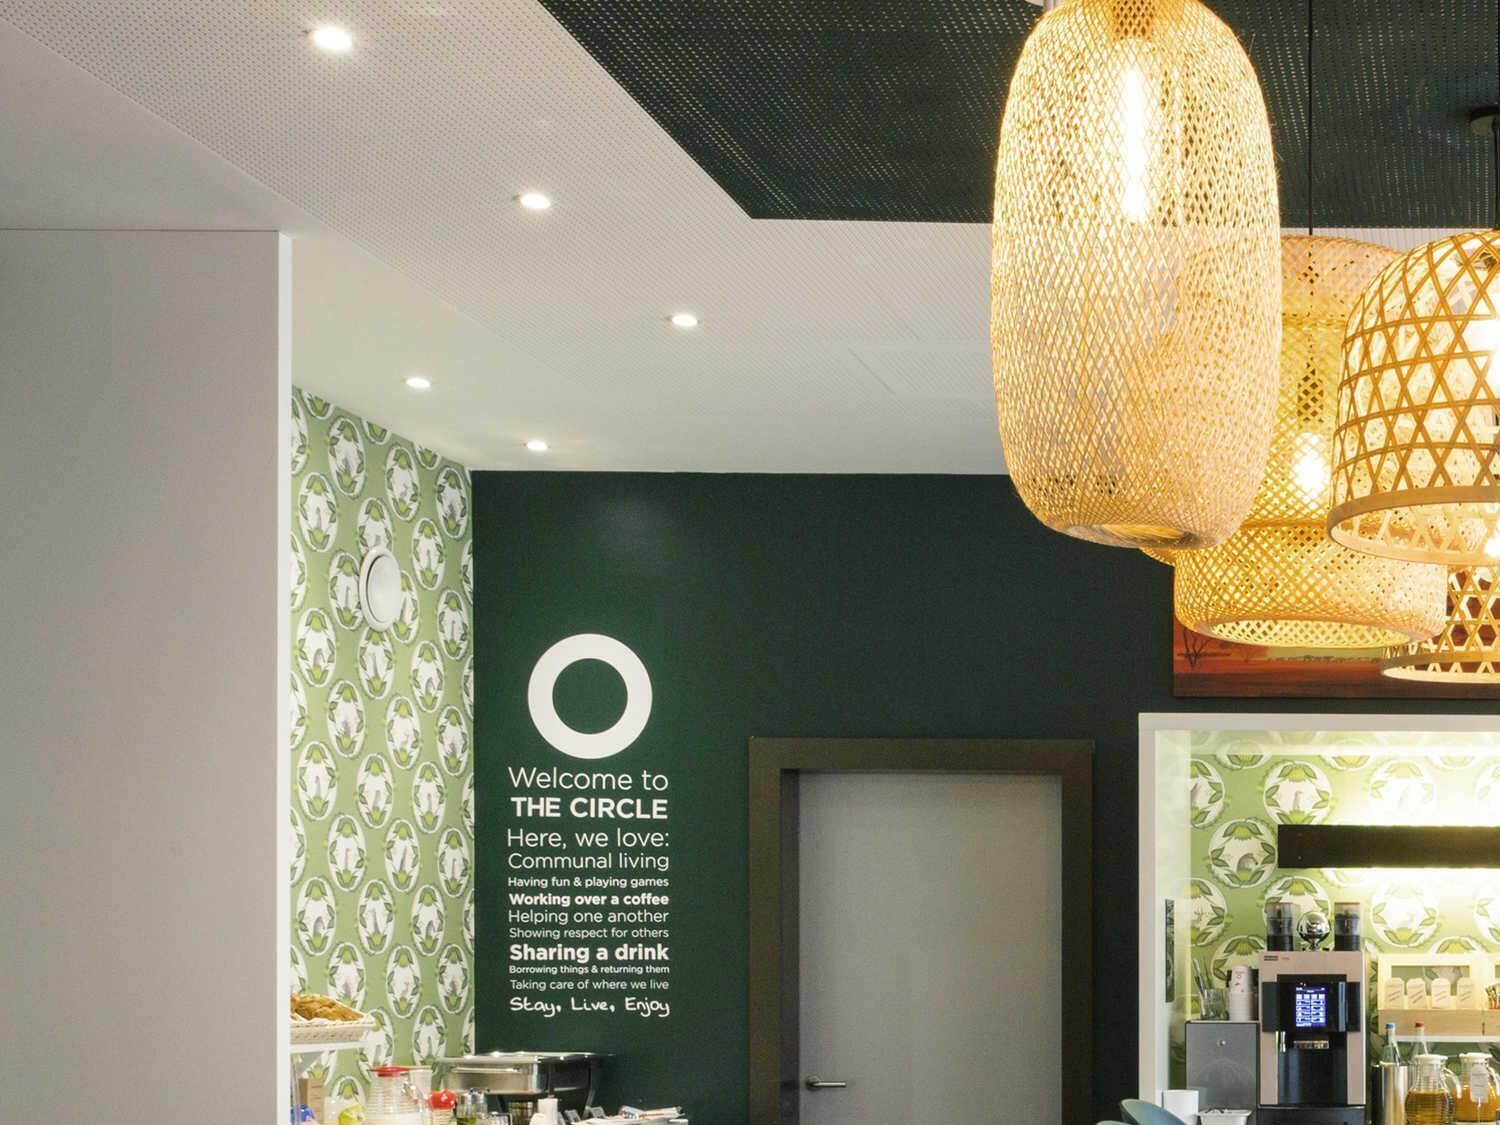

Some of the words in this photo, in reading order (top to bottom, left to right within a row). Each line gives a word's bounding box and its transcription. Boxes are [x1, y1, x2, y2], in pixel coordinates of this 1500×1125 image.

[508, 767, 632, 790] Welcome
[641, 770, 668, 791] to
[511, 797, 561, 817] THE
[570, 797, 668, 819] CIRCLE
[508, 828, 566, 849] Here,
[575, 832, 608, 847] we
[617, 828, 669, 847] love:
[508, 852, 612, 869] Communal
[619, 852, 669, 871] living
[508, 877, 548, 888] Having
[551, 876, 570, 886] fun
[573, 877, 583, 887] &
[585, 876, 627, 888] playing
[630, 879, 669, 888] games
[509, 893, 571, 907] Working
[574, 896, 607, 905] over
[610, 896, 619, 905] a
[623, 893, 669, 905] coffee
[509, 909, 568, 925] Helping
[573, 912, 603, 923] one
[608, 909, 669, 923] another
[509, 928, 560, 940] Showing
[564, 928, 608, 939] respect
[611, 927, 628, 938] for
[631, 928, 669, 937] others
[510, 944, 589, 964] Sharing
[596, 947, 608, 960] a
[614, 943, 669, 960] drink
[509, 965, 558, 975] Borrowing
[560, 965, 589, 975] things
[591, 965, 598, 973] &
[600, 965, 643, 974] returning
[646, 965, 669, 973] them
[510, 980, 546, 991] Taking
[577, 979, 589, 989] of
[592, 979, 627, 989] where
[650, 979, 669, 989] live
[510, 997, 561, 1017] Stay,
[571, 997, 615, 1012] Live,
[625, 997, 670, 1017] Enjoy
